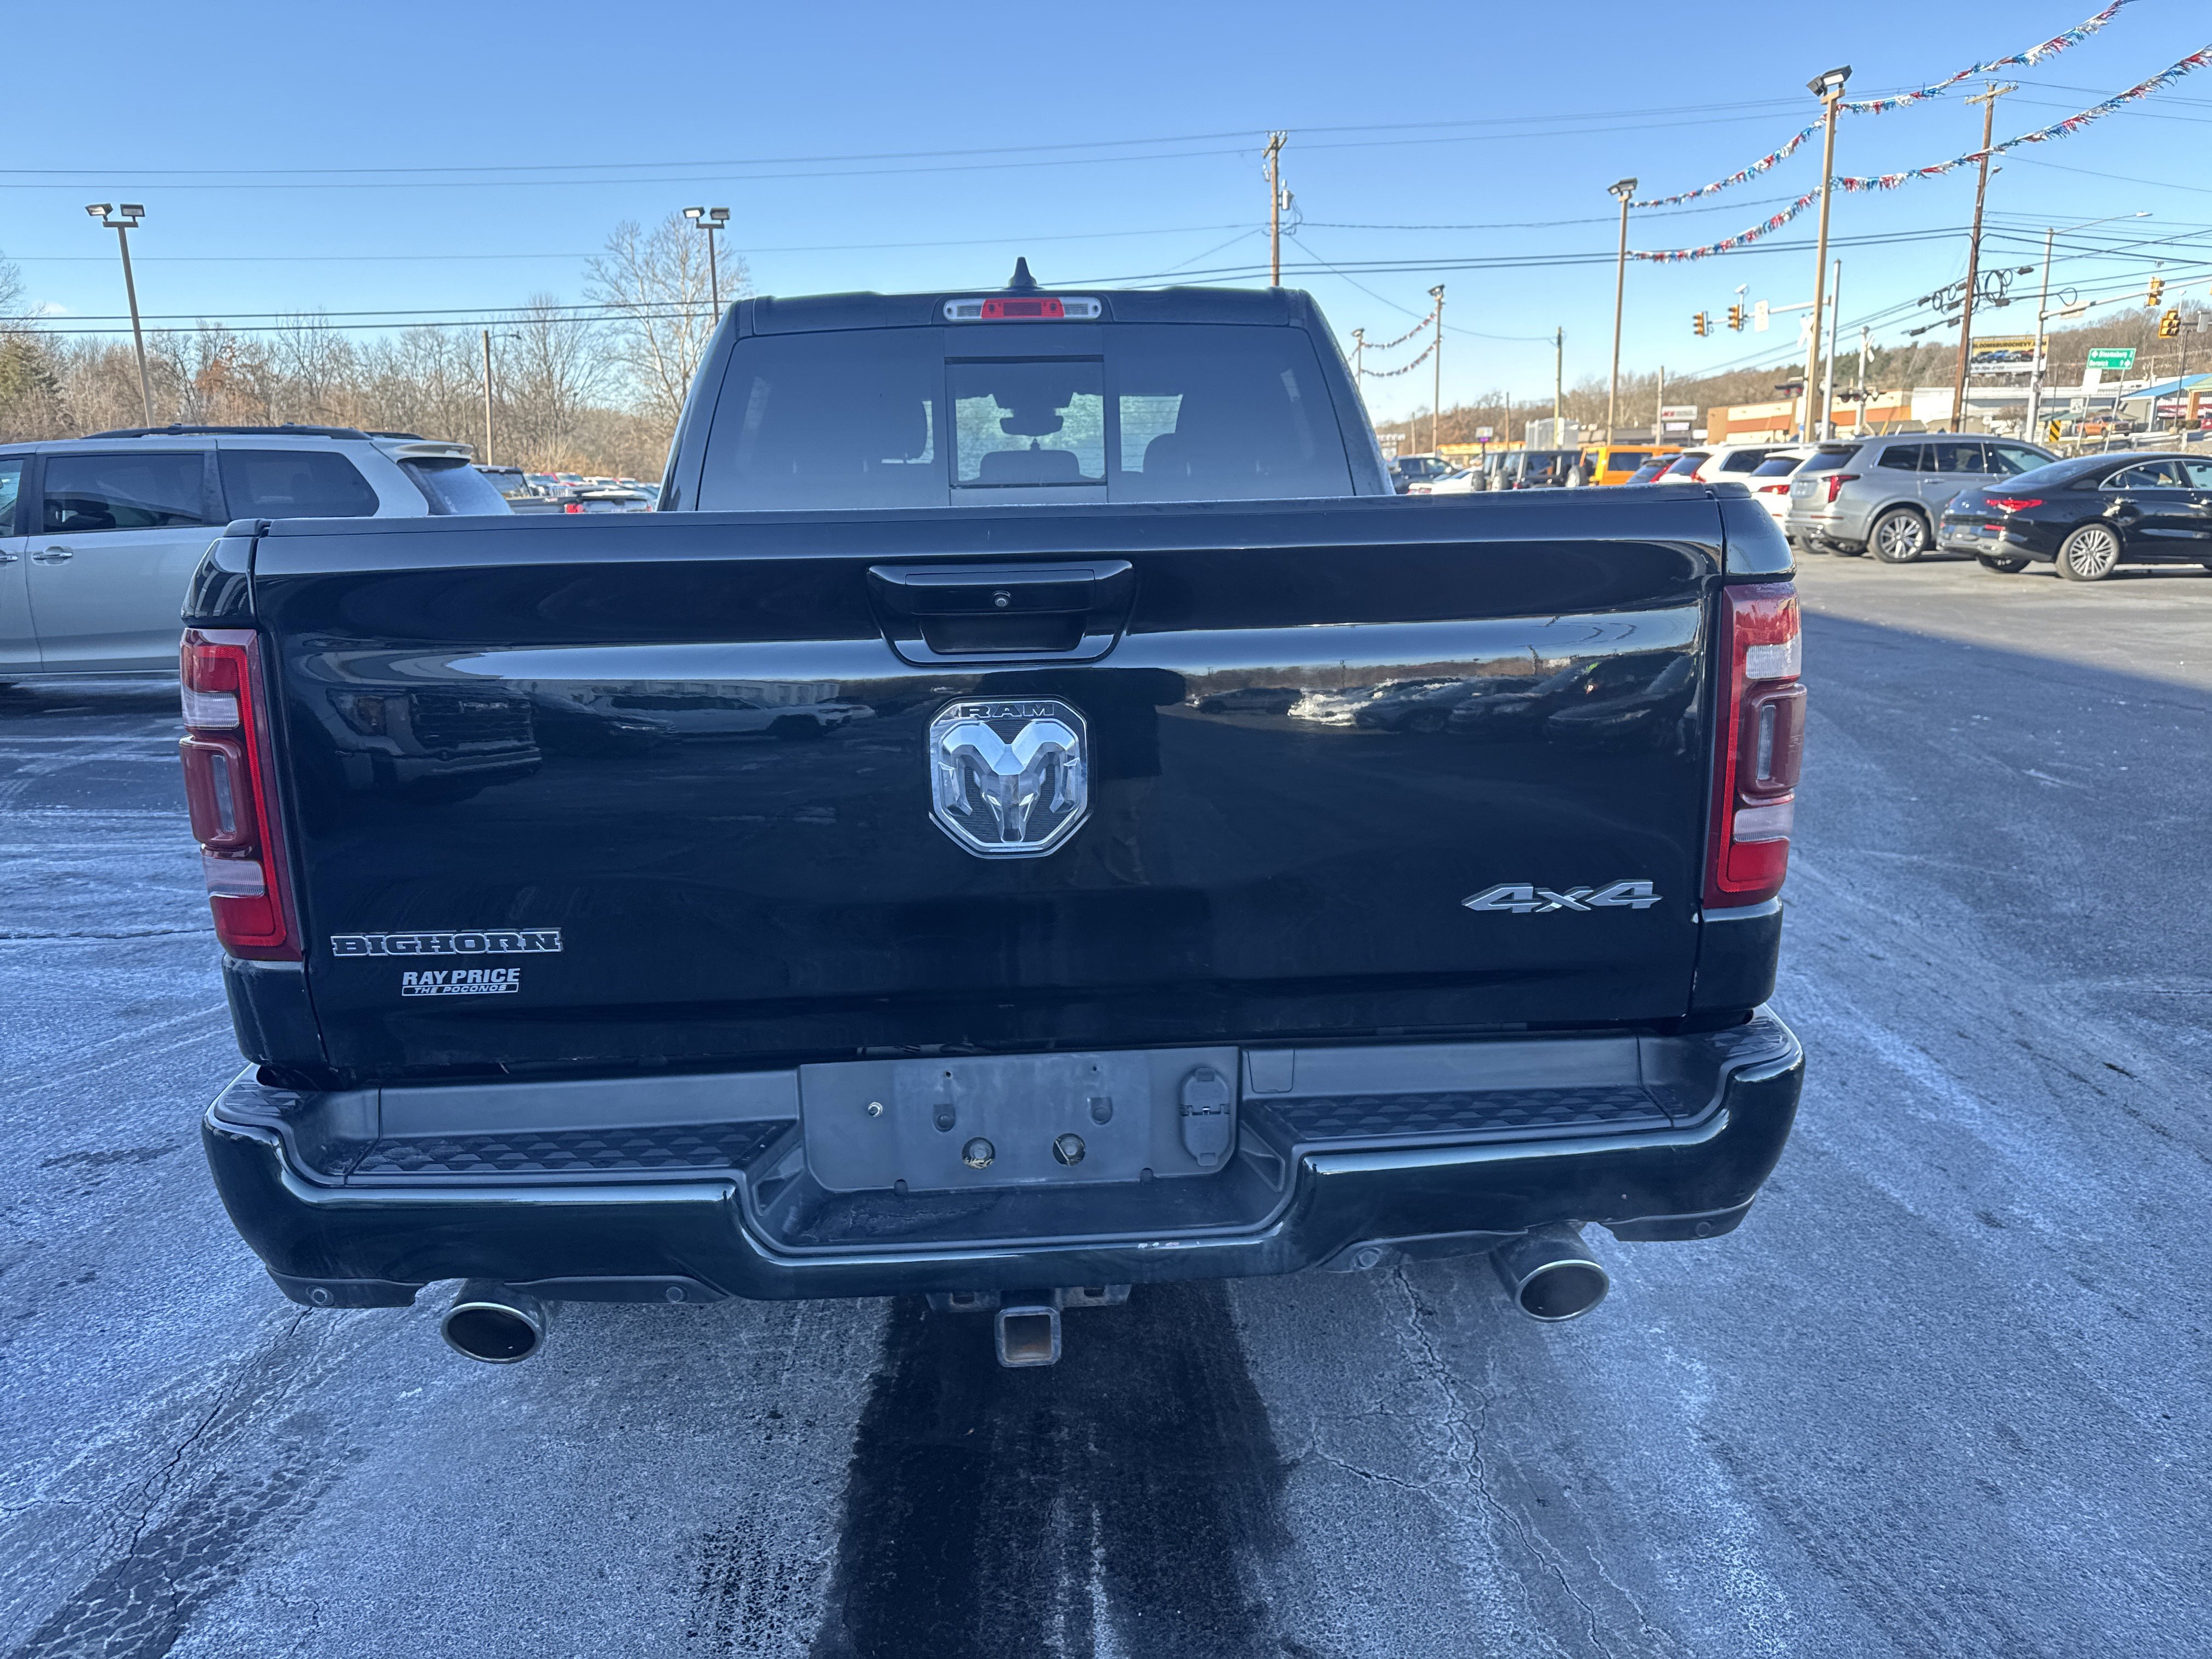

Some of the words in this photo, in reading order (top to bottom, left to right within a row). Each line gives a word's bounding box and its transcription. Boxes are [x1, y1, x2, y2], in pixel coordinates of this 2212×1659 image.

[959, 703, 1054, 718] RAM
[330, 927, 564, 956] BIGHORN
[403, 970, 449, 985] RAY
[451, 968, 521, 984] PRICE
[442, 984, 507, 994] POCONOS
